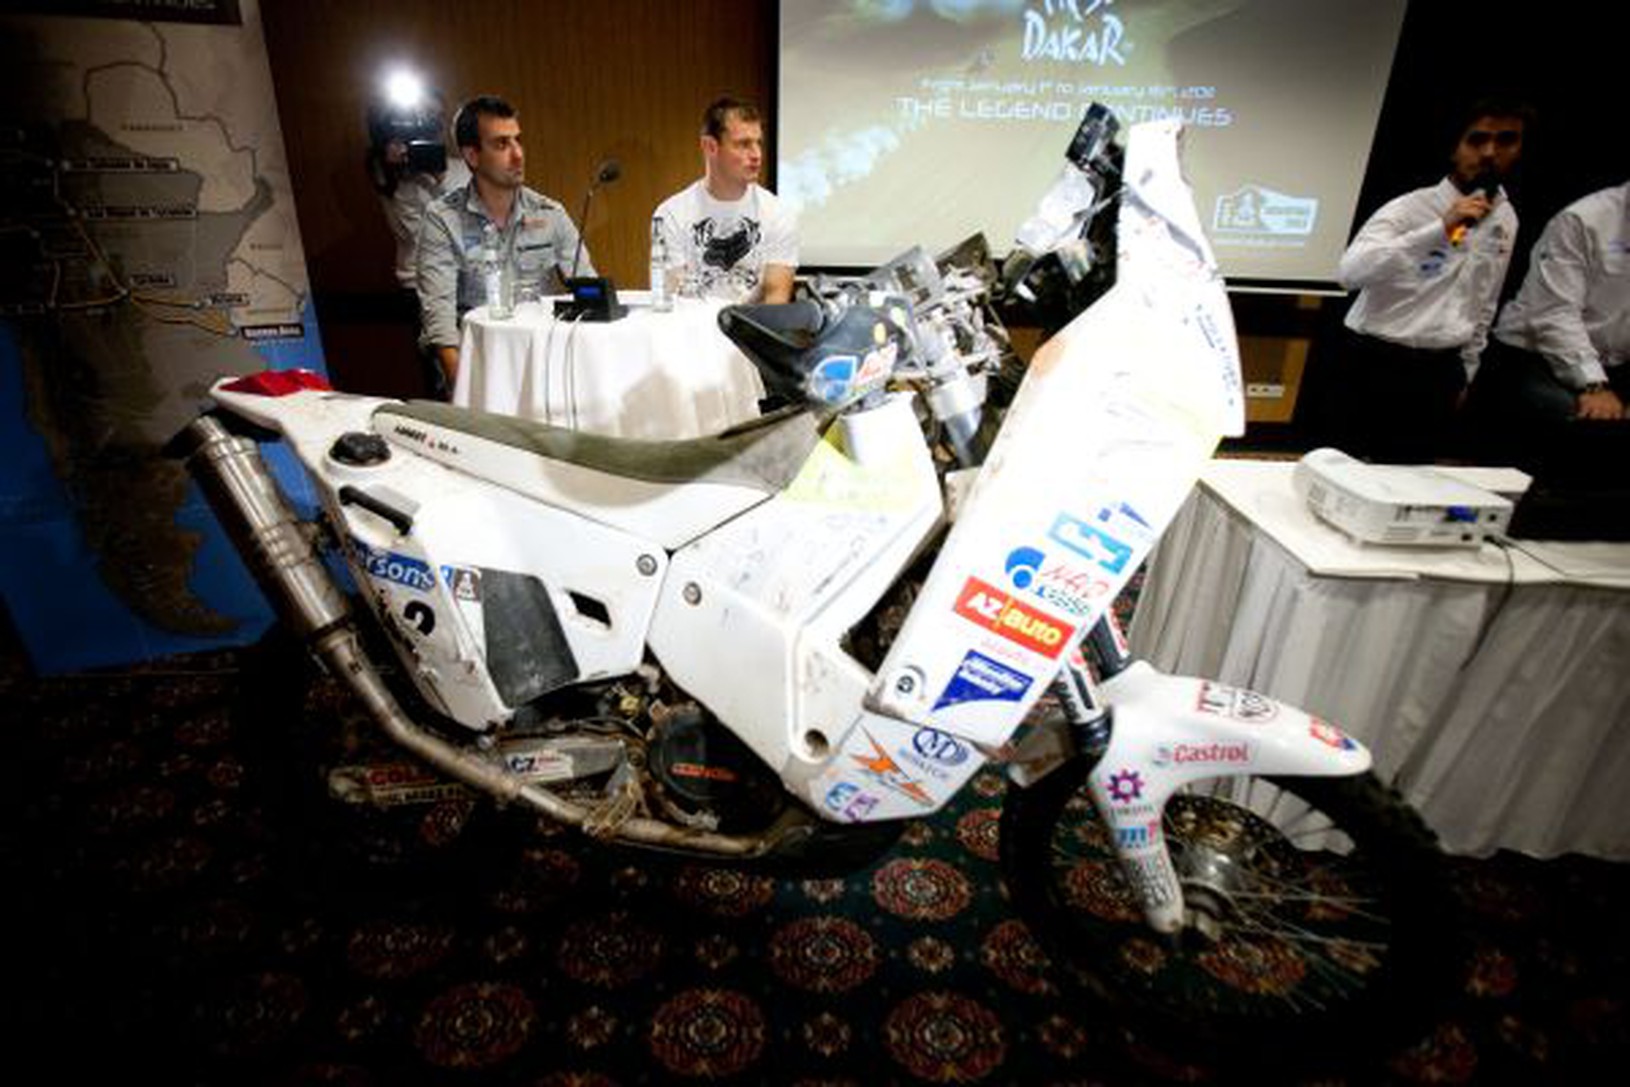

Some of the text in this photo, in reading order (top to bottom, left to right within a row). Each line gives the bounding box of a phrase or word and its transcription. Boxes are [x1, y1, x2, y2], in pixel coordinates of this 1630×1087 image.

[1021, 12, 1126, 66] DAKAR
[897, 96, 1234, 126] THE LEGEND NTINUES
[966, 591, 1004, 622] AZ
[1173, 740, 1249, 763] Castrol
